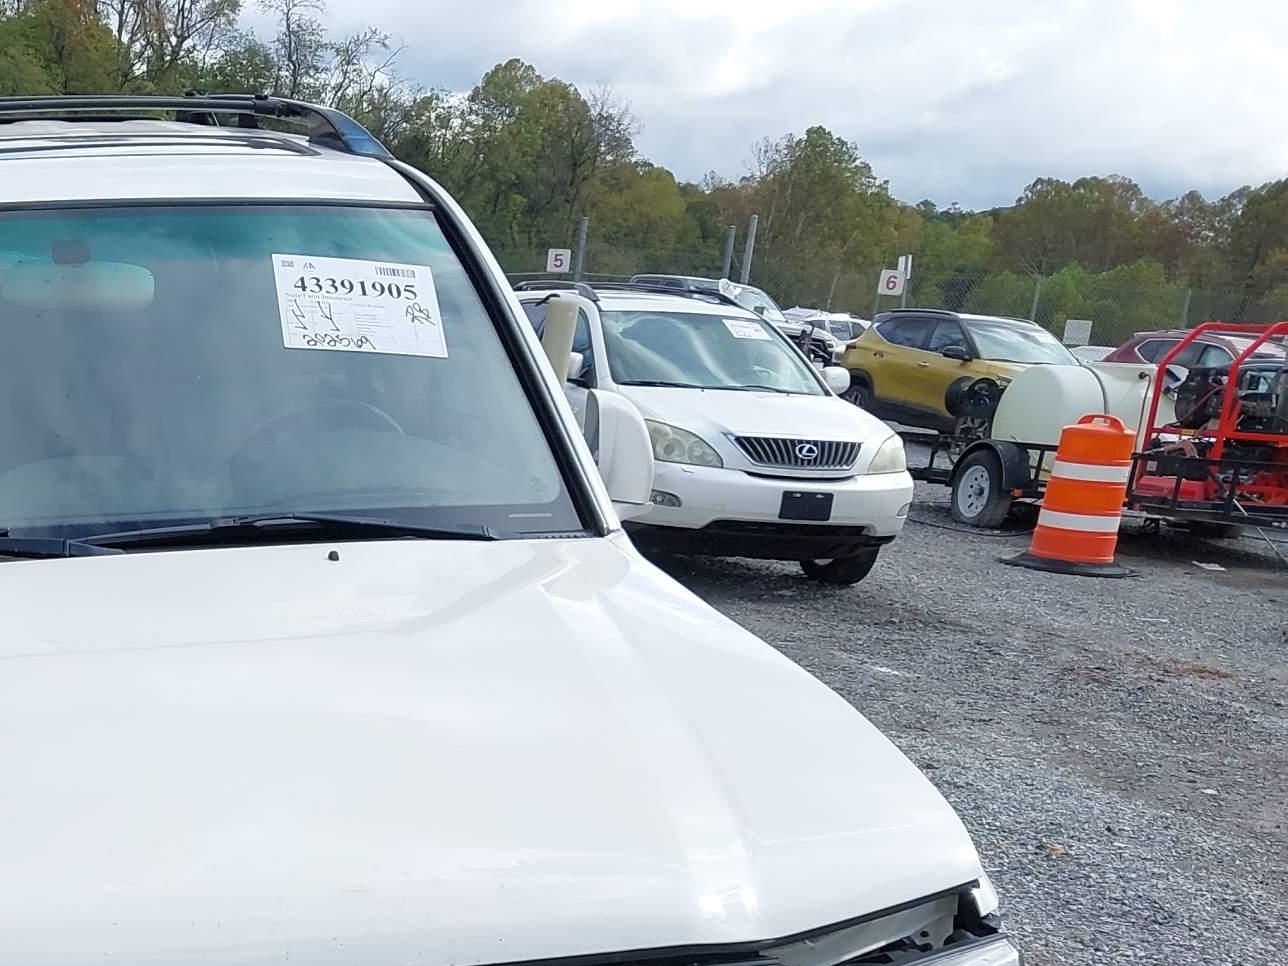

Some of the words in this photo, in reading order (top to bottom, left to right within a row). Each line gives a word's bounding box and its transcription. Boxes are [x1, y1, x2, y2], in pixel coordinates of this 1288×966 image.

[553, 253, 564, 268] 5
[293, 275, 418, 301] 43391905
[886, 275, 898, 290] 6
